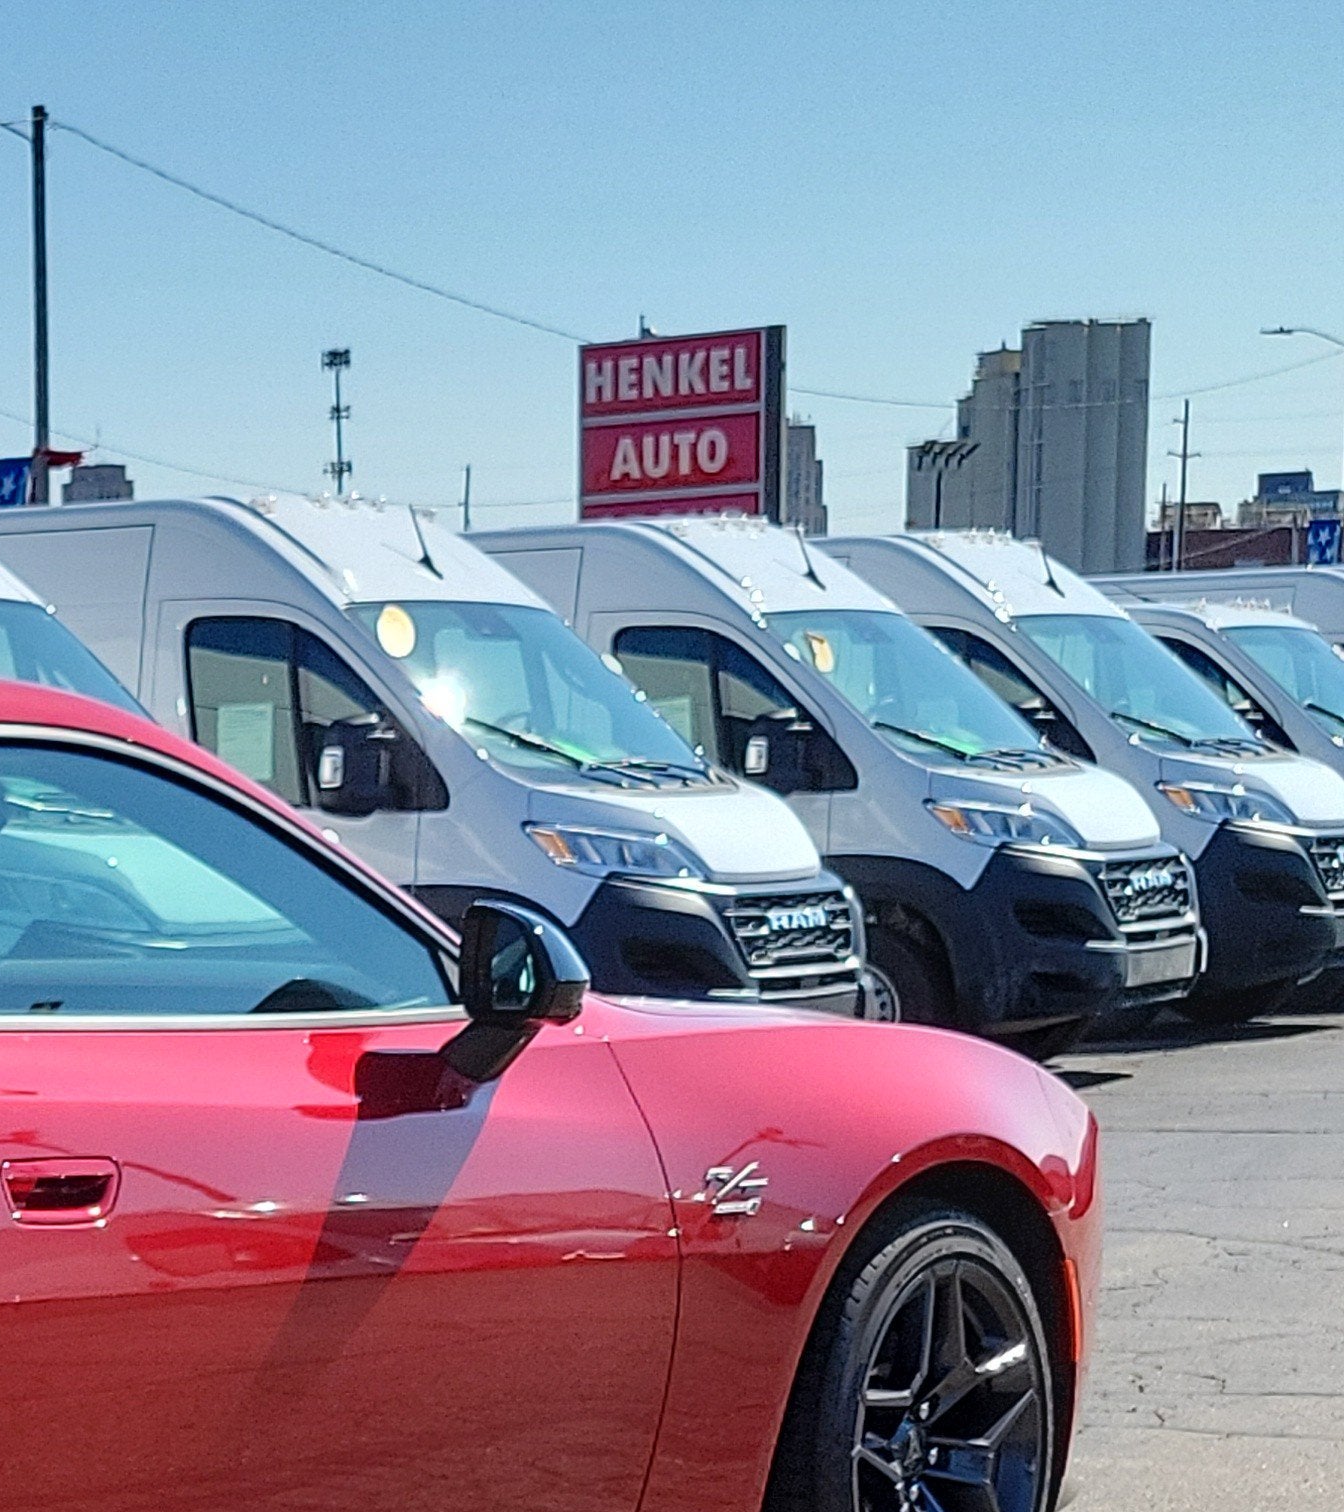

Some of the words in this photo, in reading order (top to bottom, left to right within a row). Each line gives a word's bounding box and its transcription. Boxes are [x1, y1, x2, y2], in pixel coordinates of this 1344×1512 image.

[585, 347, 753, 403] HENKEL
[610, 429, 728, 481] AUTO
[767, 906, 827, 930] RAM
